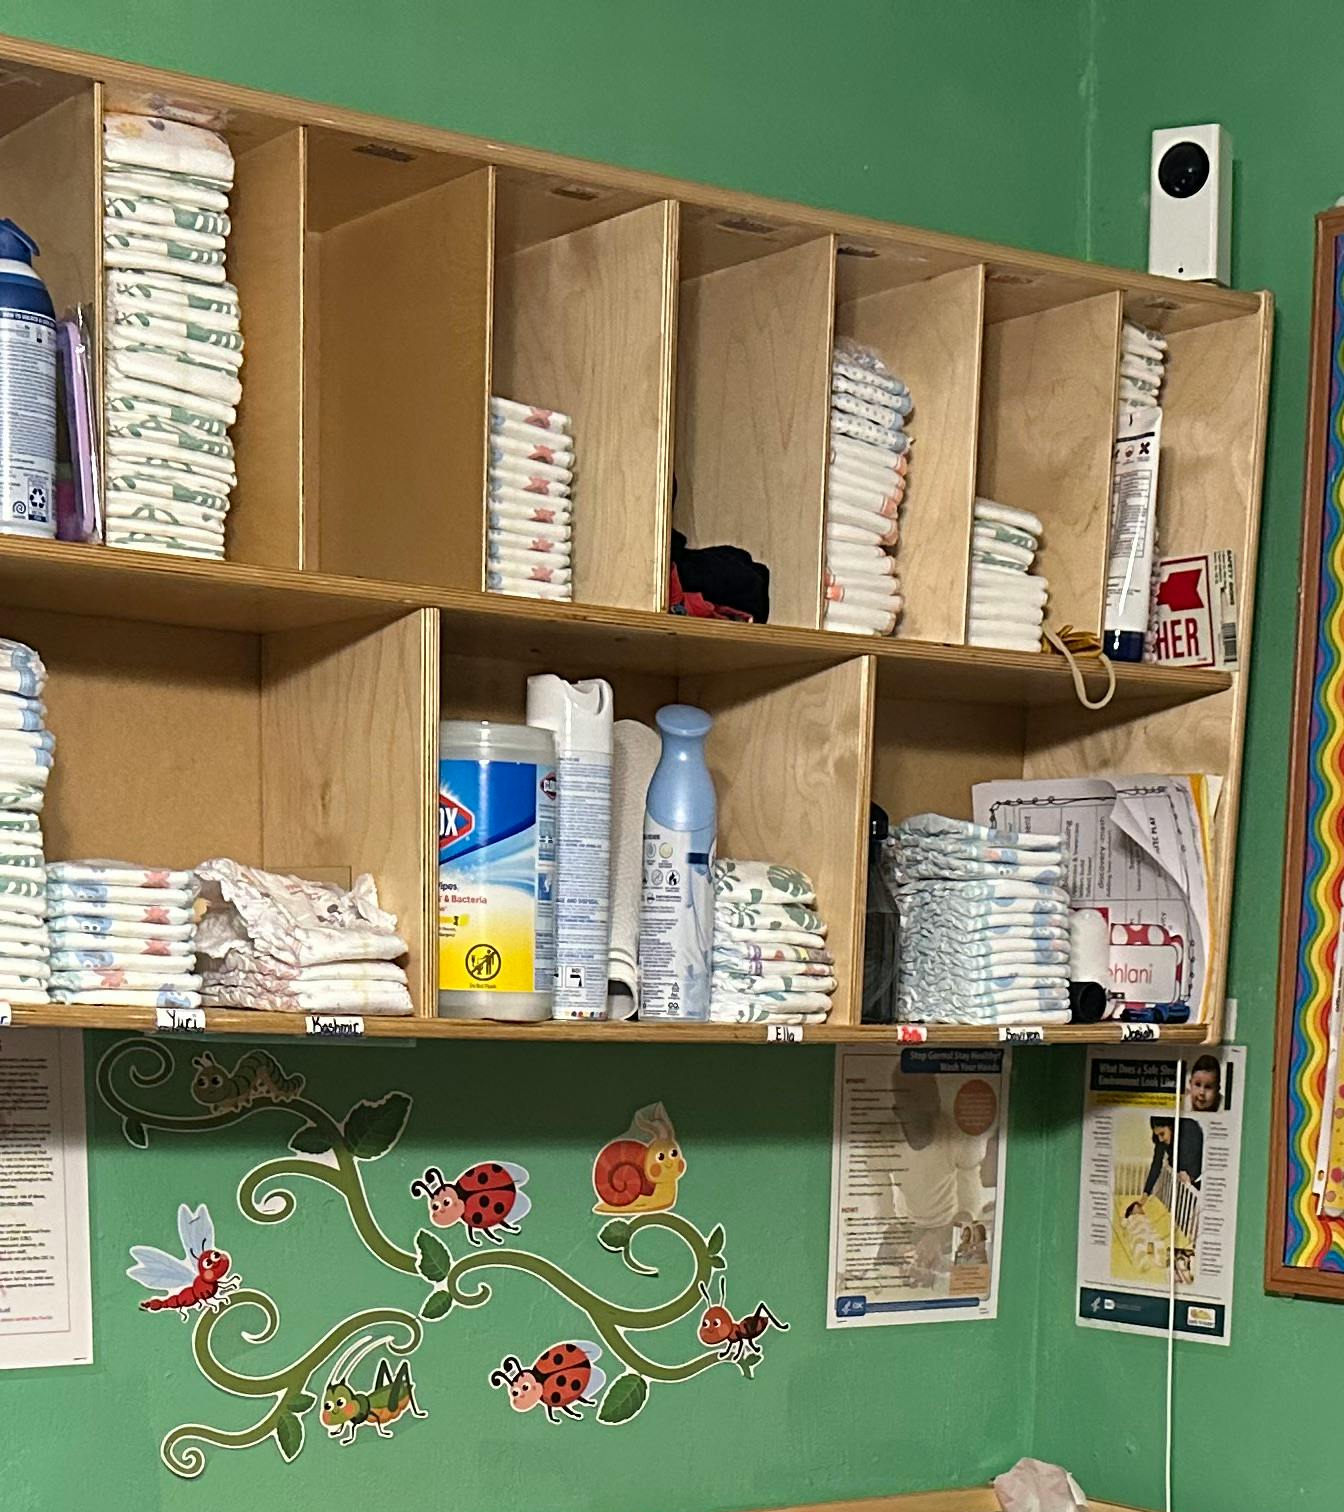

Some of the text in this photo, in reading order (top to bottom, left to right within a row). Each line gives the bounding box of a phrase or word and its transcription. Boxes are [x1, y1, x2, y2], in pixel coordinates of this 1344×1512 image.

[451, 895, 487, 904] Bacteria
[166, 1010, 198, 1030] Yuri
[1123, 1024, 1154, 1041] Josiah
